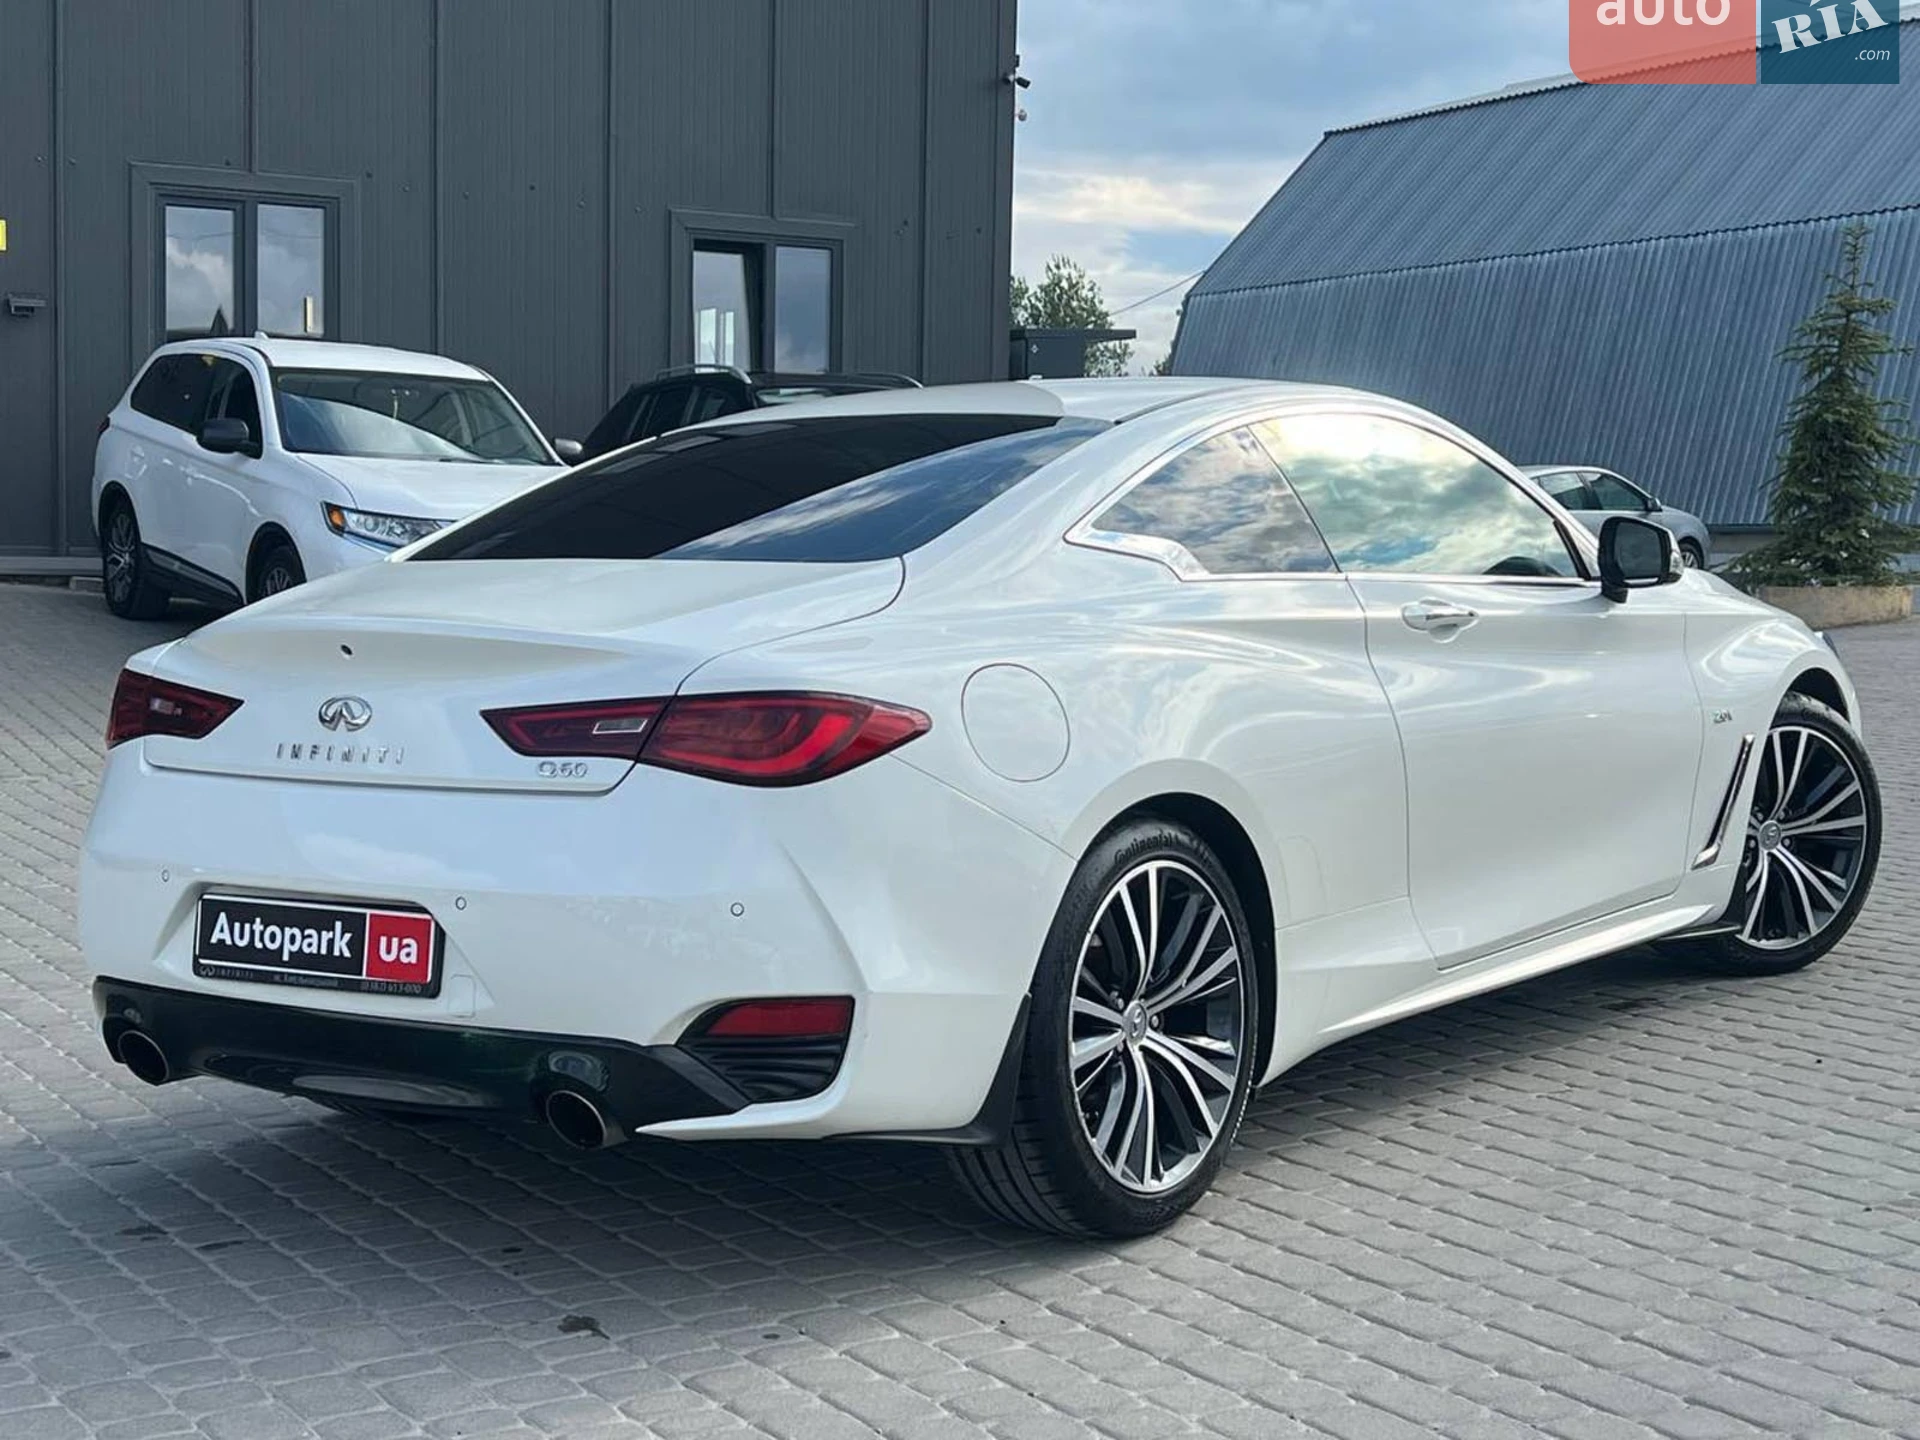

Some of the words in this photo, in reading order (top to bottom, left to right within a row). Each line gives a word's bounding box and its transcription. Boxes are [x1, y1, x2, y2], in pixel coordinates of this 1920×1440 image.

[276, 742, 406, 765] INFINITI
[538, 760, 589, 779] Q60
[209, 911, 353, 962] Autopark
[378, 934, 418, 965] ua
